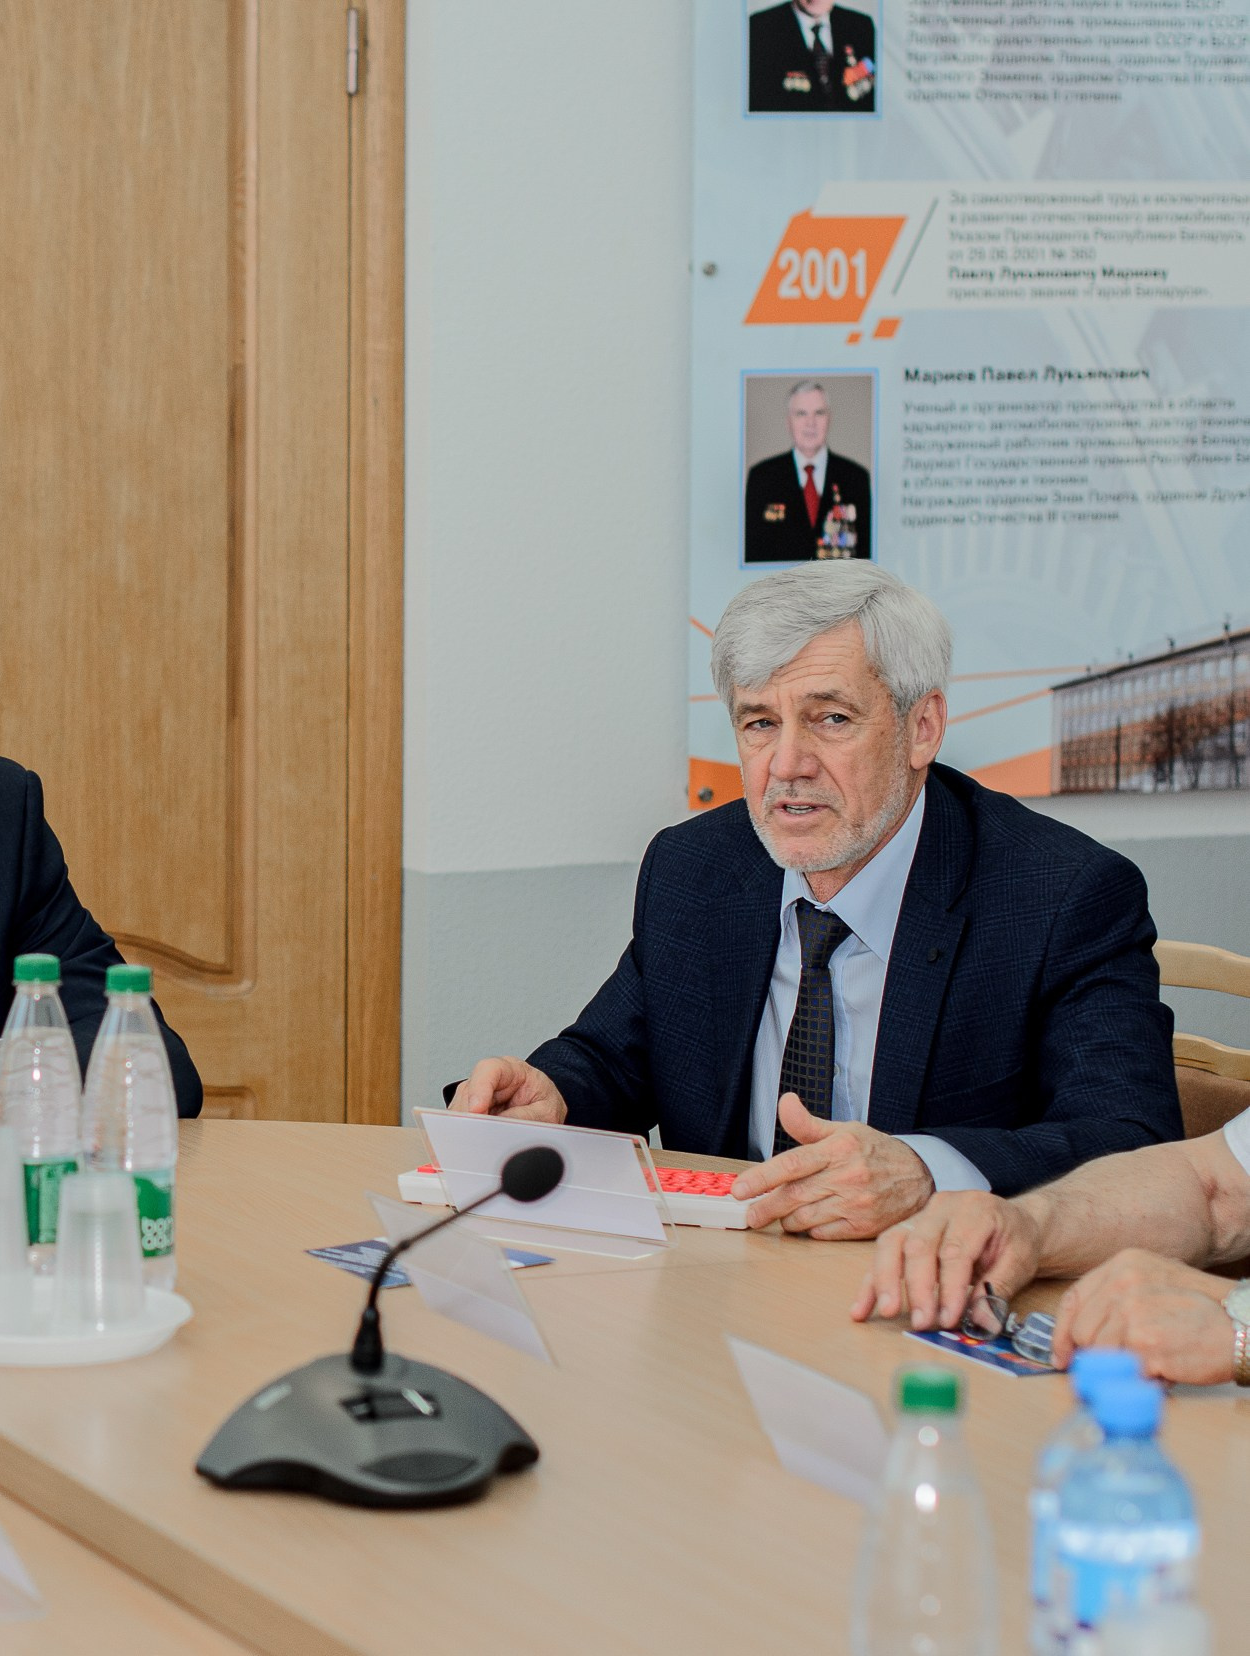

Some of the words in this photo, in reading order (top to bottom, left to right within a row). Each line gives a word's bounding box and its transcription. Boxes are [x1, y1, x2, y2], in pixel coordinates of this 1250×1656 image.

[777, 247, 867, 300] 2001
[903, 367, 976, 385] Мариев
[981, 366, 1038, 381] Павел
[1043, 366, 1152, 384] Лукьянович
